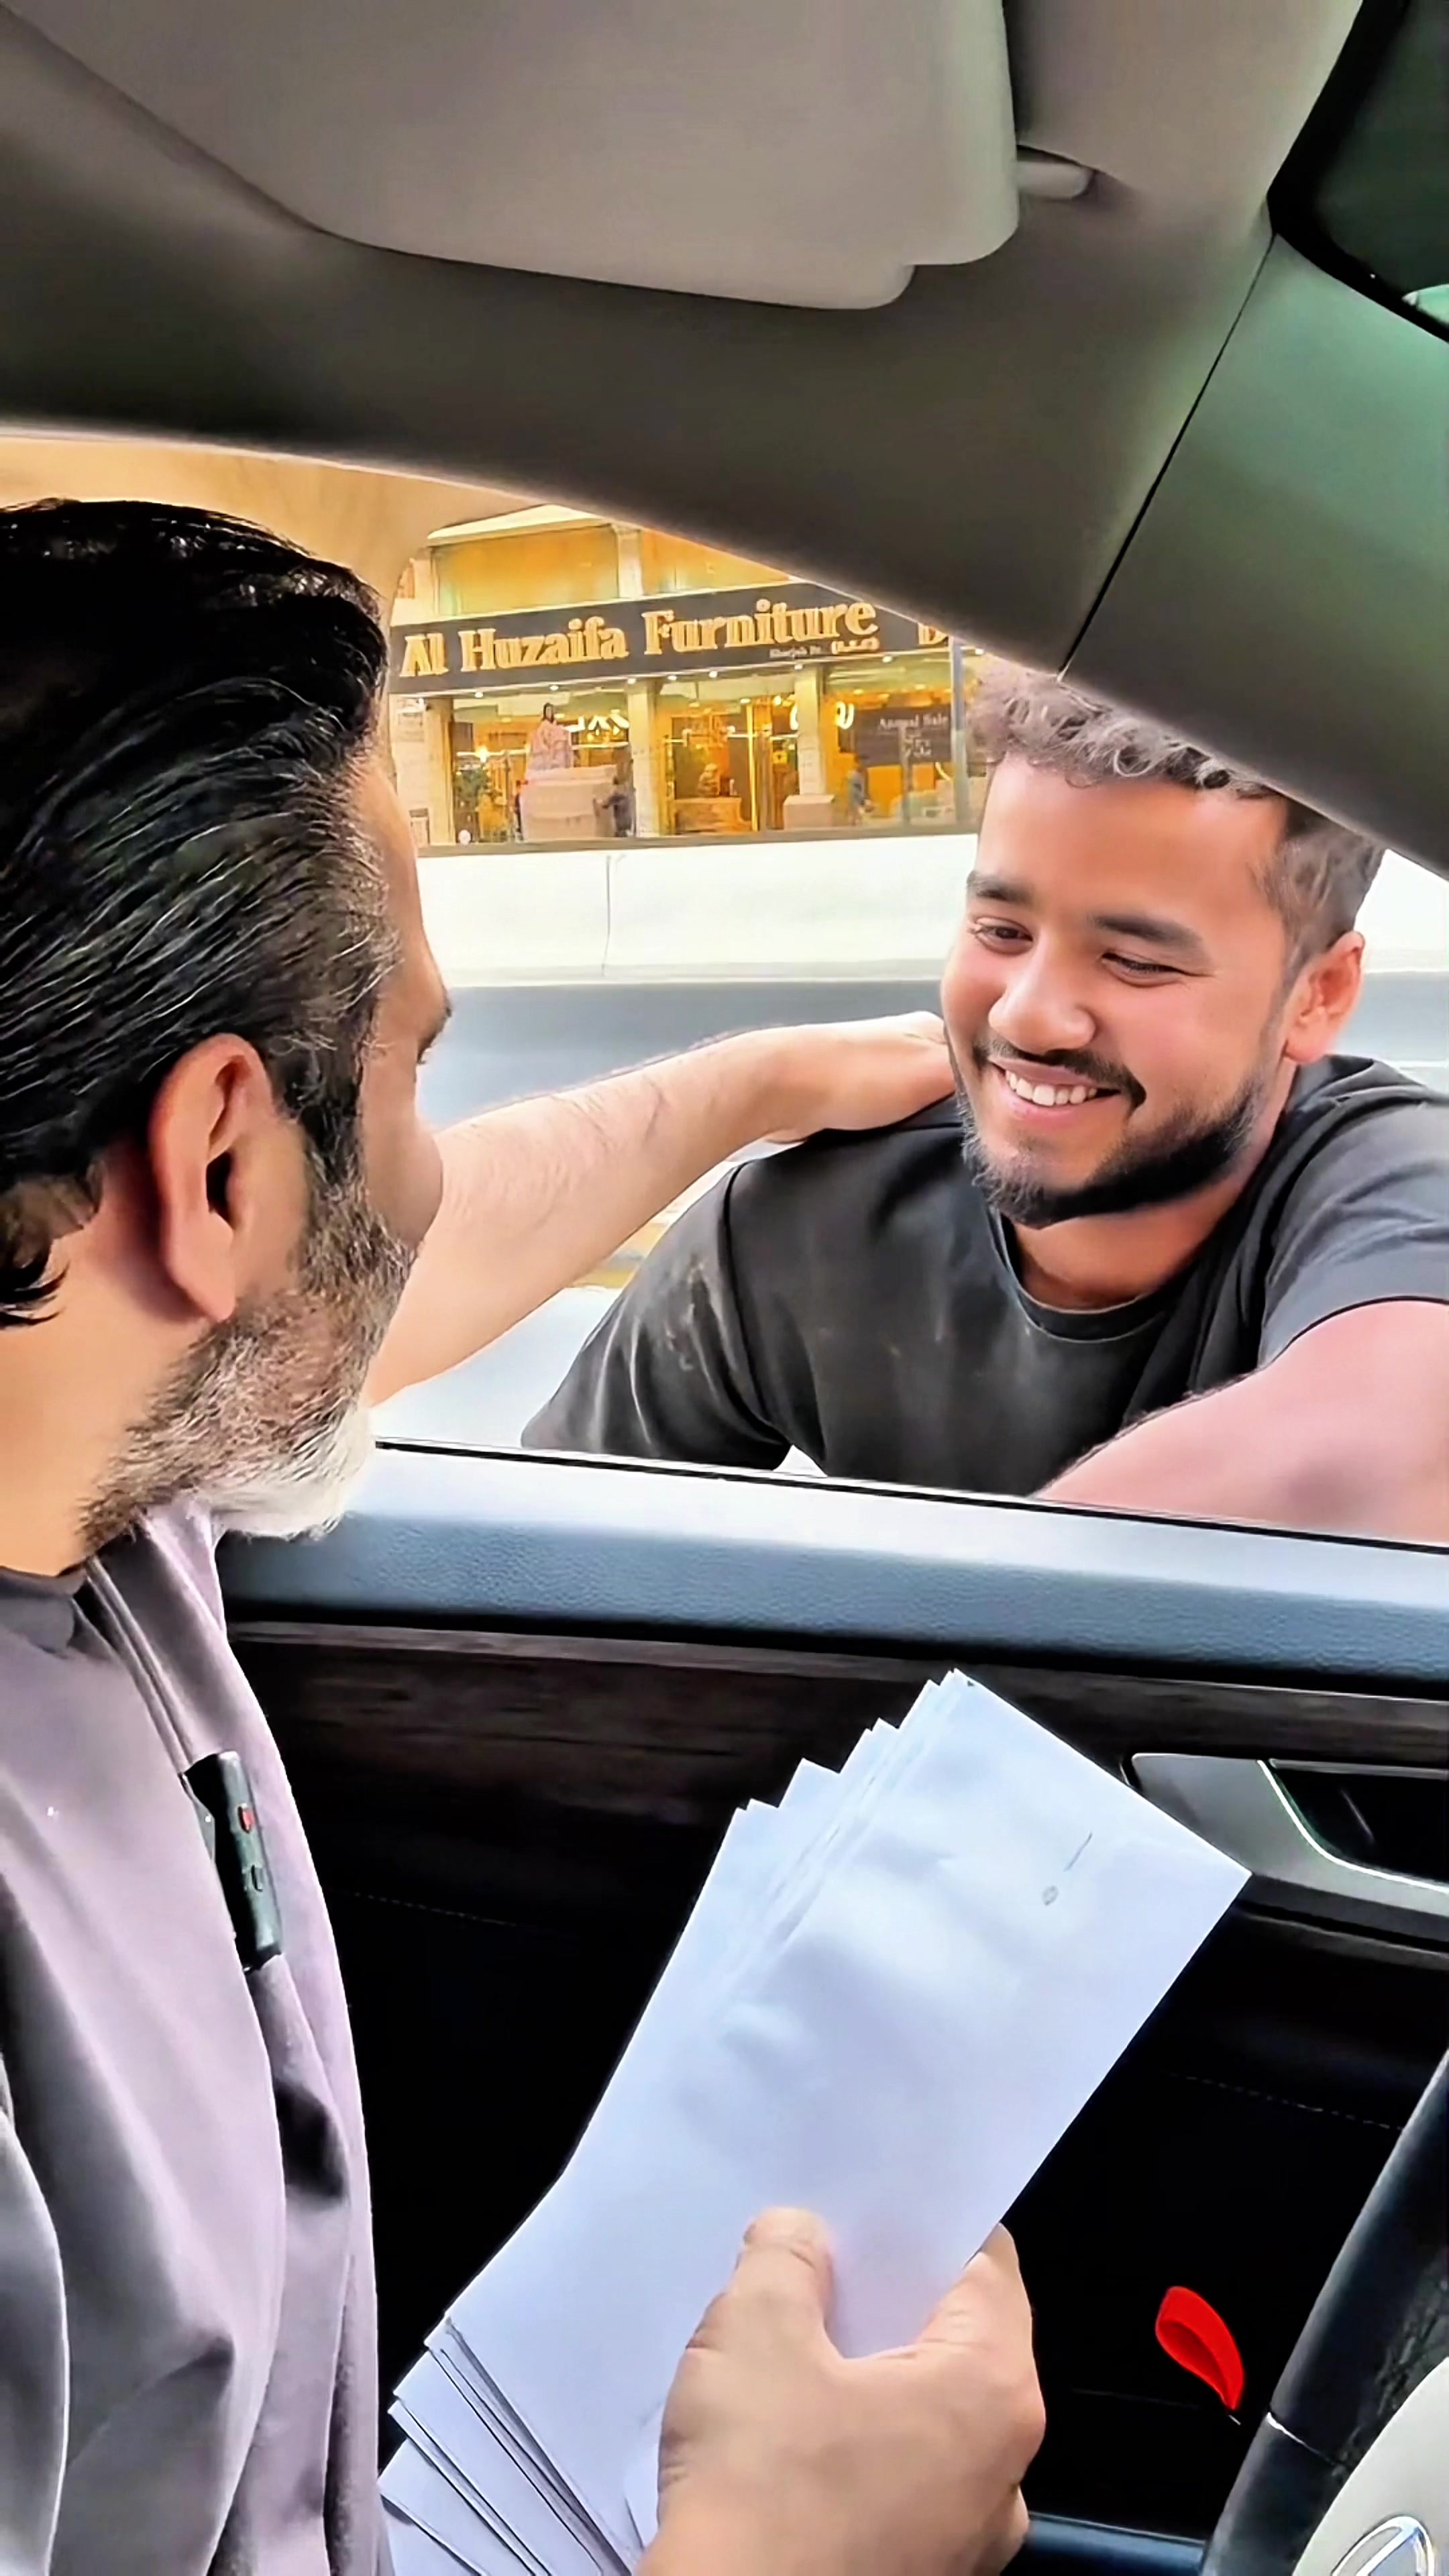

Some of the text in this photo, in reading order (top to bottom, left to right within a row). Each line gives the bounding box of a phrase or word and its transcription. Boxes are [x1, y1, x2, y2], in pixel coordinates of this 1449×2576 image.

[399, 598, 879, 677] Al Huzaifa Furniture
